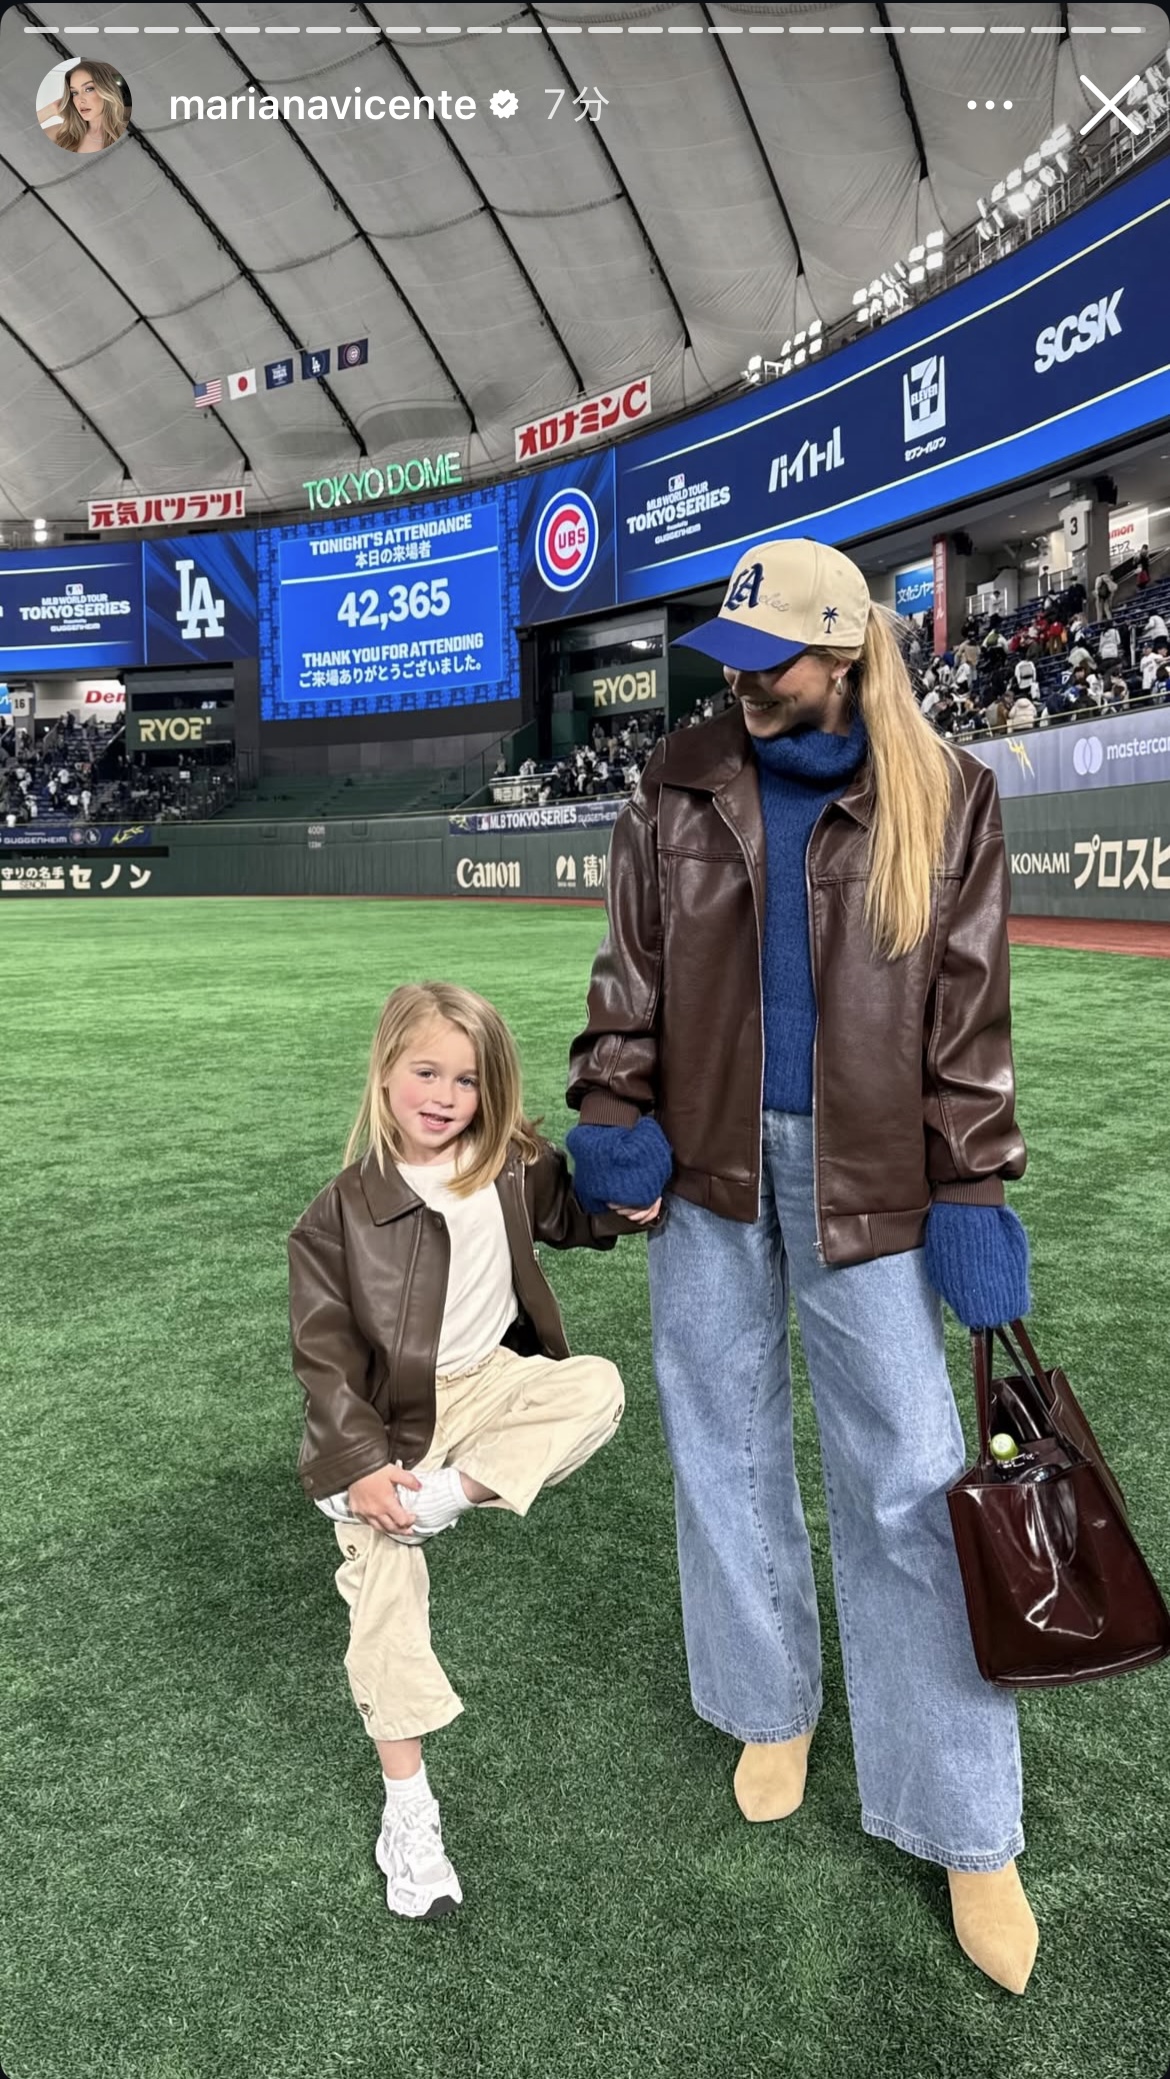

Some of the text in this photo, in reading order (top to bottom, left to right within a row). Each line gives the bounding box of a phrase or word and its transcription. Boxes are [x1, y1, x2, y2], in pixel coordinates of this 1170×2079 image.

[1034, 287, 1125, 374] SCSK
[518, 380, 648, 460] オロナミンC
[768, 425, 845, 493] バイトル
[302, 452, 464, 511] TOKYO DOME
[662, 488, 689, 506] WORLD
[688, 480, 709, 497] TOUR
[626, 486, 731, 534] TOKYO SERIES
[309, 513, 473, 556] TONIGHT'S ATTENDANCE
[1069, 516, 1079, 536] 3
[355, 540, 432, 569] 本日の来場者
[19, 601, 131, 620] TOKYO SERIES
[59, 594, 87, 605] WORLD
[87, 593, 109, 603] TOUR
[175, 559, 225, 640] LA
[337, 577, 451, 632] 42,365
[302, 632, 484, 669] THANK YOU FOR ATTENDING
[14, 698, 26, 709] 16
[592, 669, 657, 708] RYOBI
[138, 716, 212, 743] RYOB
[489, 814, 506, 829] MLB
[507, 810, 540, 828] TOKYO
[541, 807, 577, 826] SERIES
[69, 864, 152, 889] セノン
[456, 857, 521, 888] Canon
[1011, 852, 1070, 875] KONAMI
